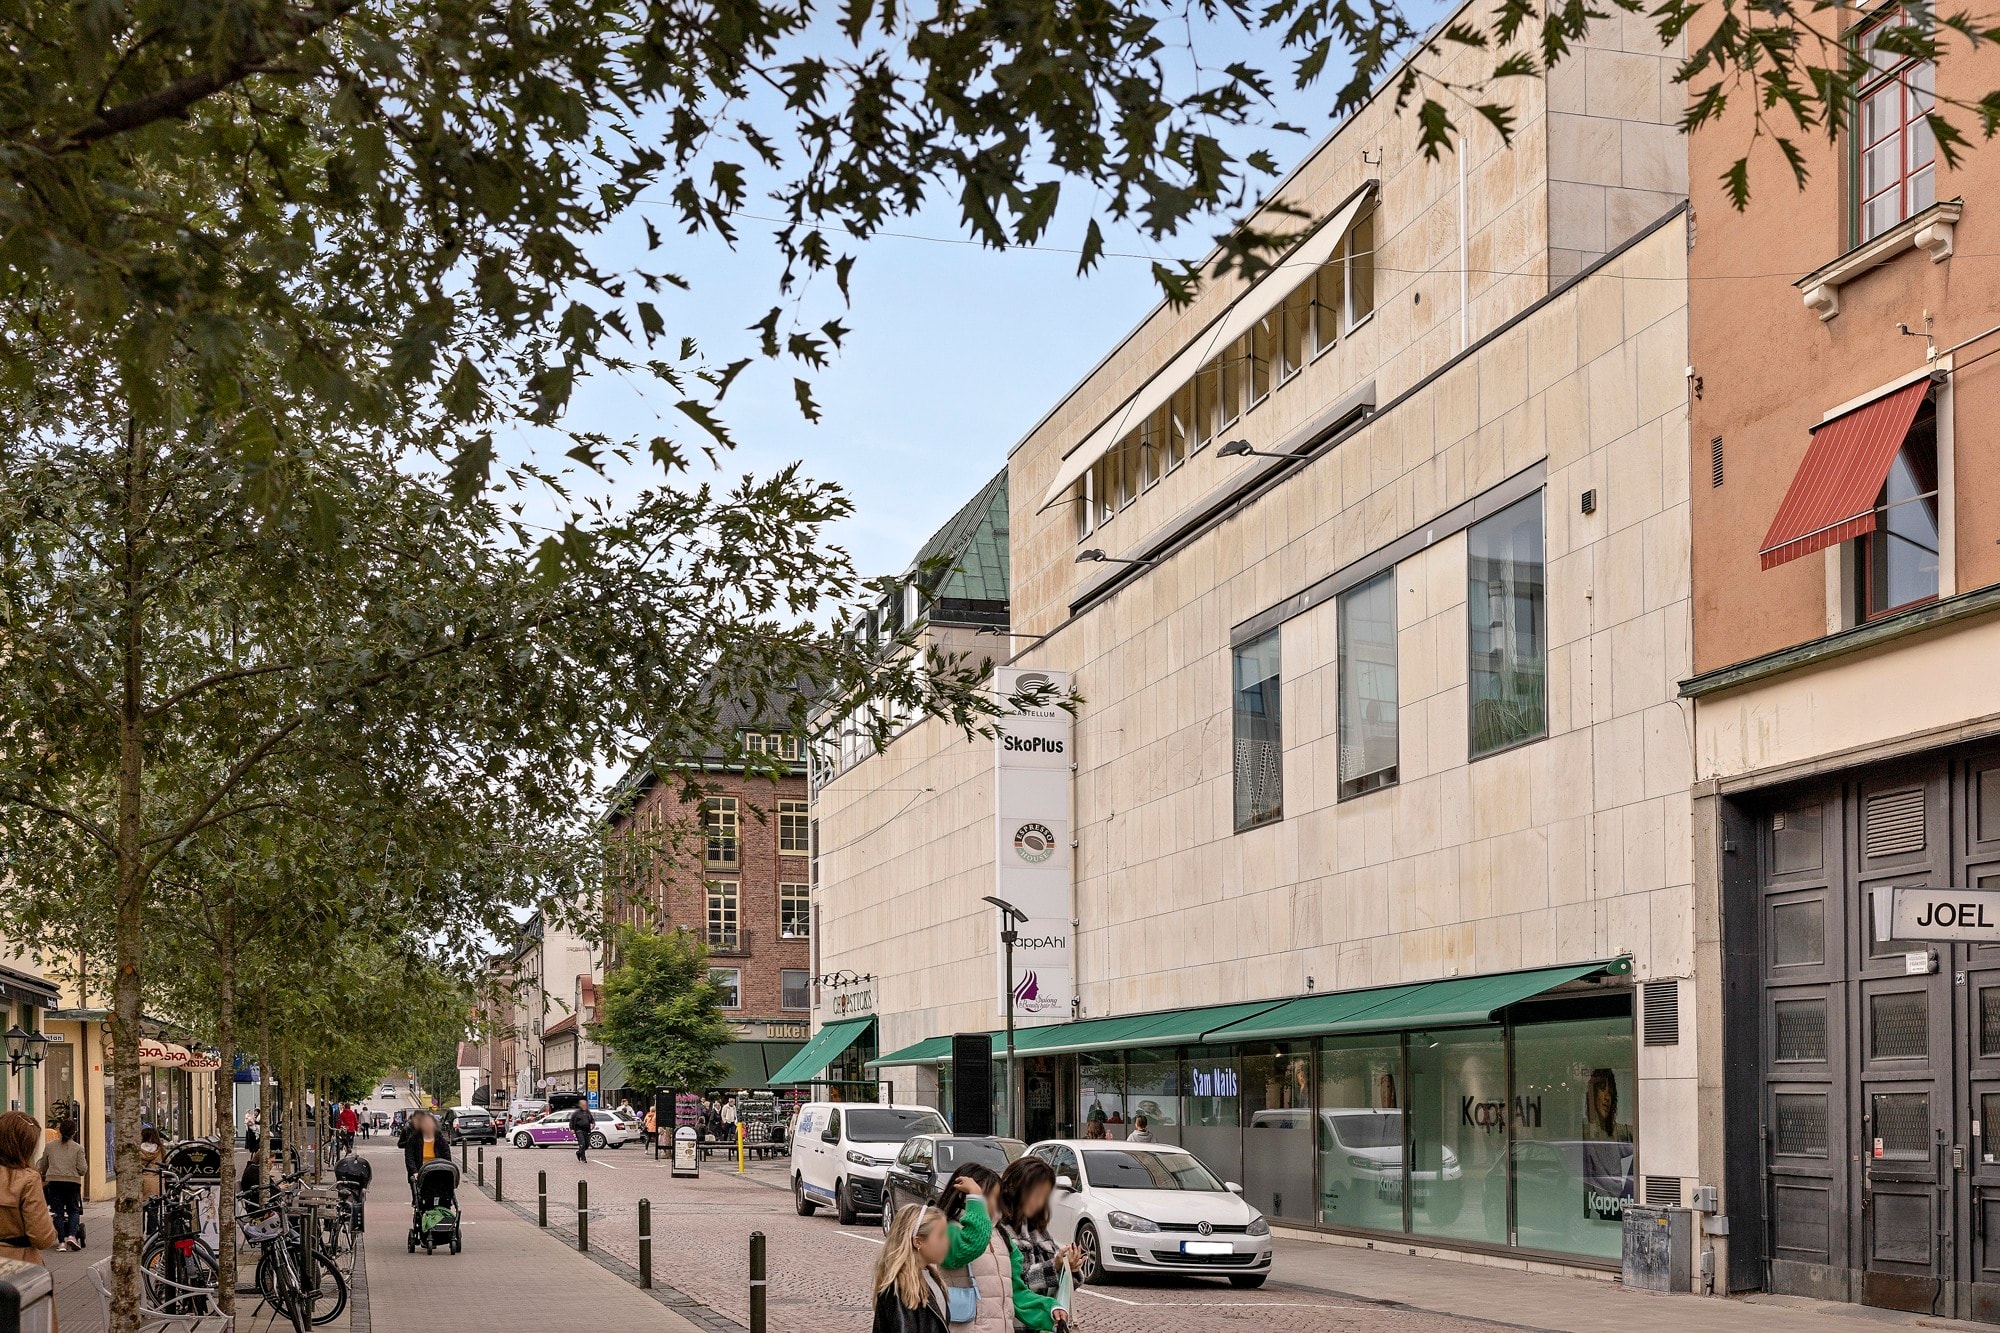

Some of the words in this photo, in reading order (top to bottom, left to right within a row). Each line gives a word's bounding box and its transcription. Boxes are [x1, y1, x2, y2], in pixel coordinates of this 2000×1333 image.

[1004, 735, 1064, 754] SkoPlus
[1016, 824, 1053, 841] ESPRESSO
[1020, 851, 1050, 862] HOUSE
[1917, 902, 1994, 928] JOEL
[1012, 935, 1066, 951] appAhl
[1193, 1068, 1212, 1097] Sam
[1214, 1068, 1238, 1097] Nails
